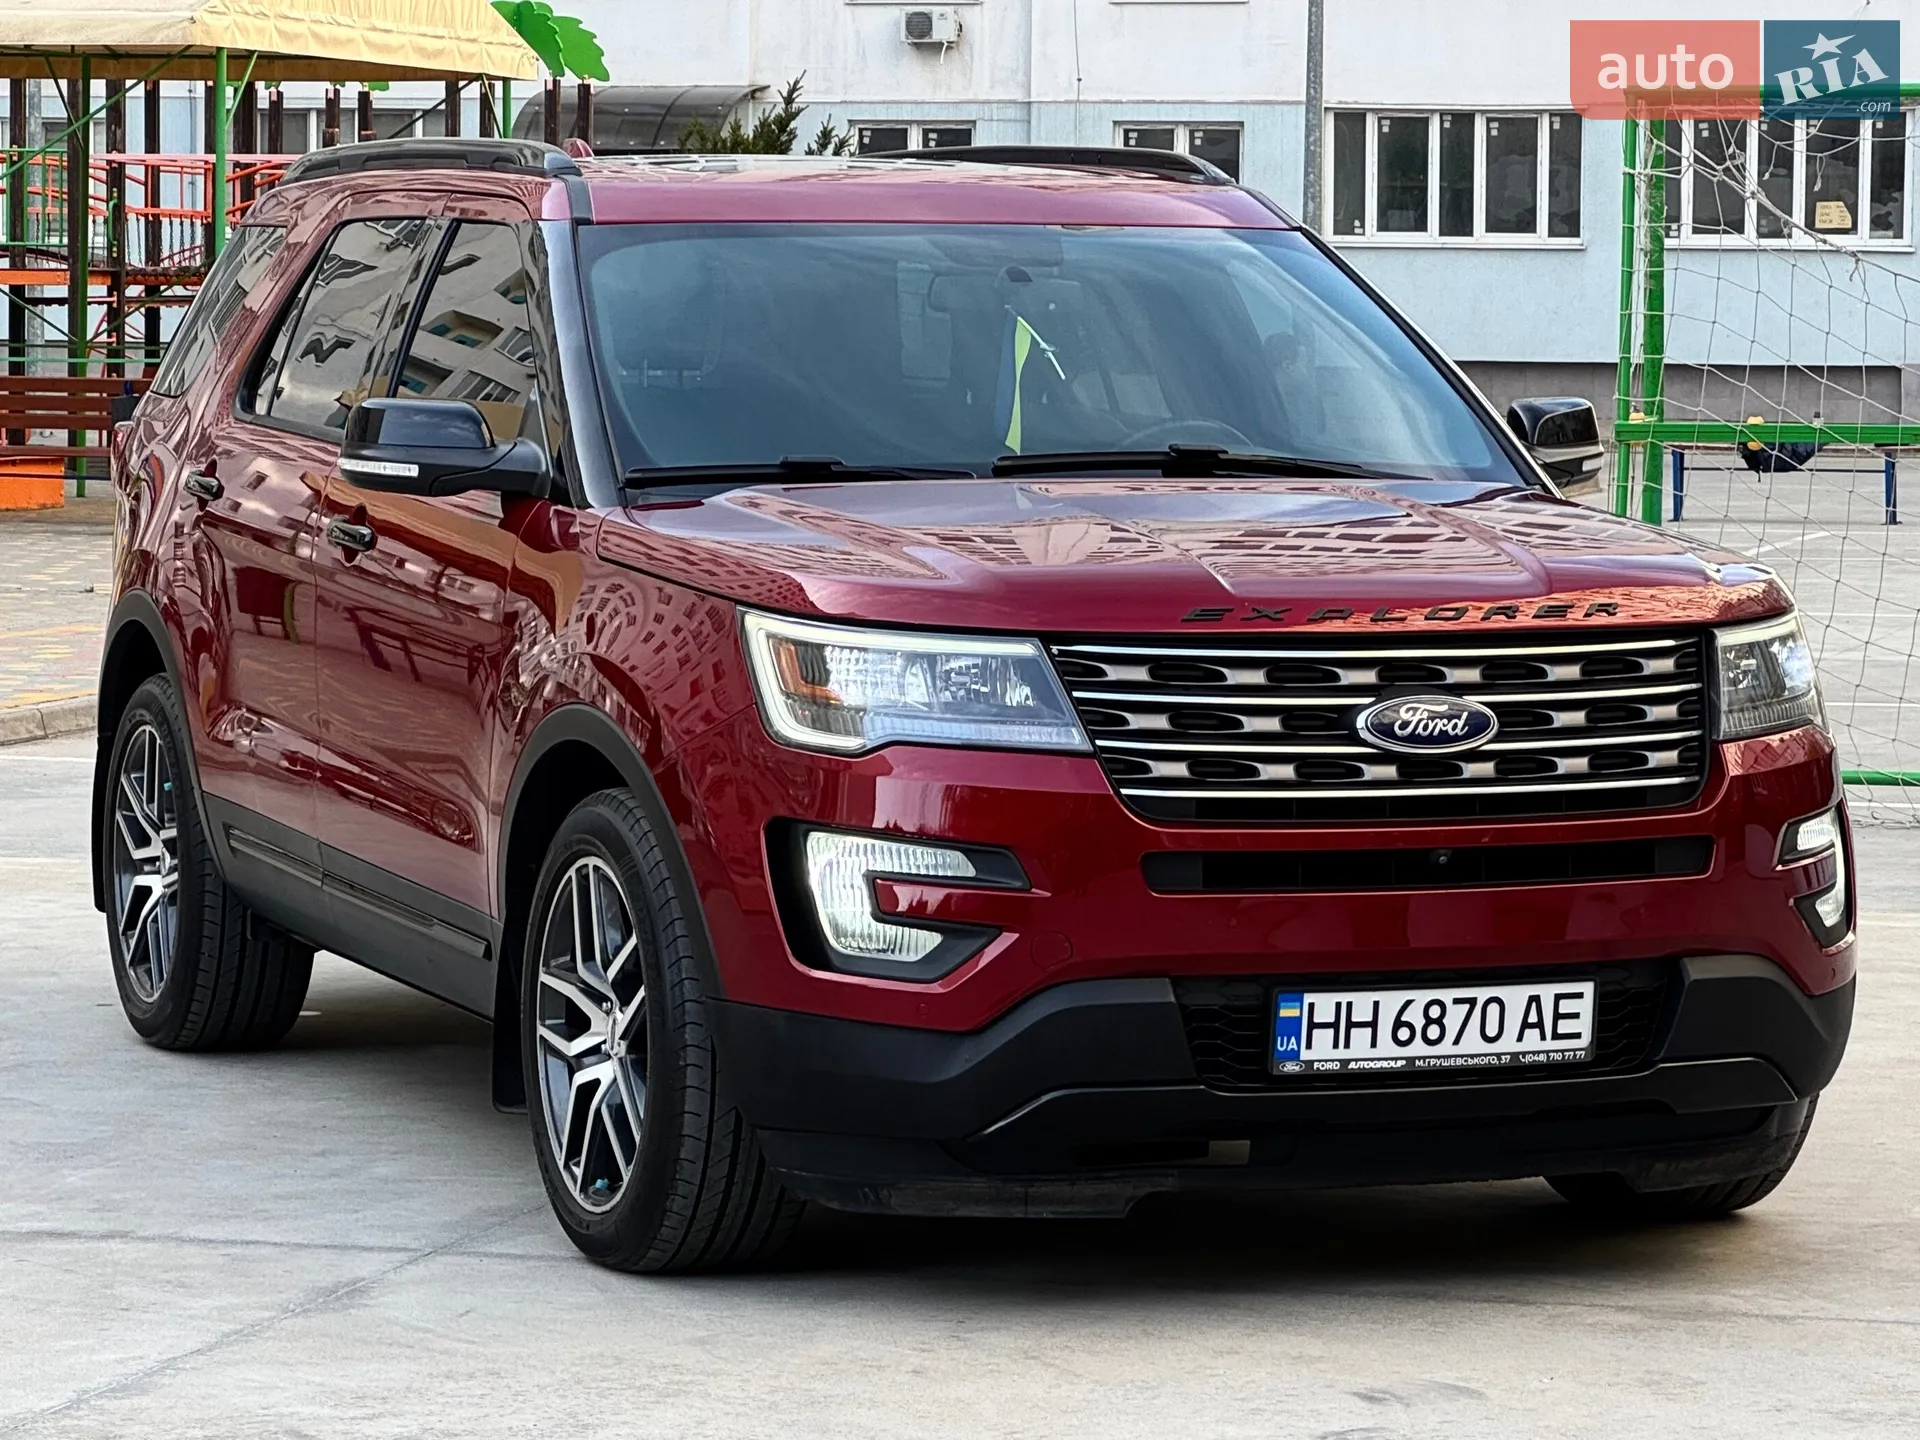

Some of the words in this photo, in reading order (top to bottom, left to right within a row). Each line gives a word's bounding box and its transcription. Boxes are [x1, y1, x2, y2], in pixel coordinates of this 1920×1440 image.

[1180, 602, 1619, 622] EXPLORER
[1393, 704, 1470, 737] Ford
[1305, 1000, 1380, 1050] HH
[1391, 996, 1506, 1048] 6870
[1516, 992, 1585, 1043] AE
[1277, 1036, 1298, 1051] UA
[1500, 1055, 1511, 1064] 37
[1525, 1053, 1547, 1063] (048)
[1549, 1052, 1563, 1061] 710
[1563, 1051, 1574, 1060] 77
[1575, 1050, 1586, 1059] 77
[1313, 1061, 1340, 1070] FORD
[1348, 1059, 1406, 1069] AUTOGROUP
